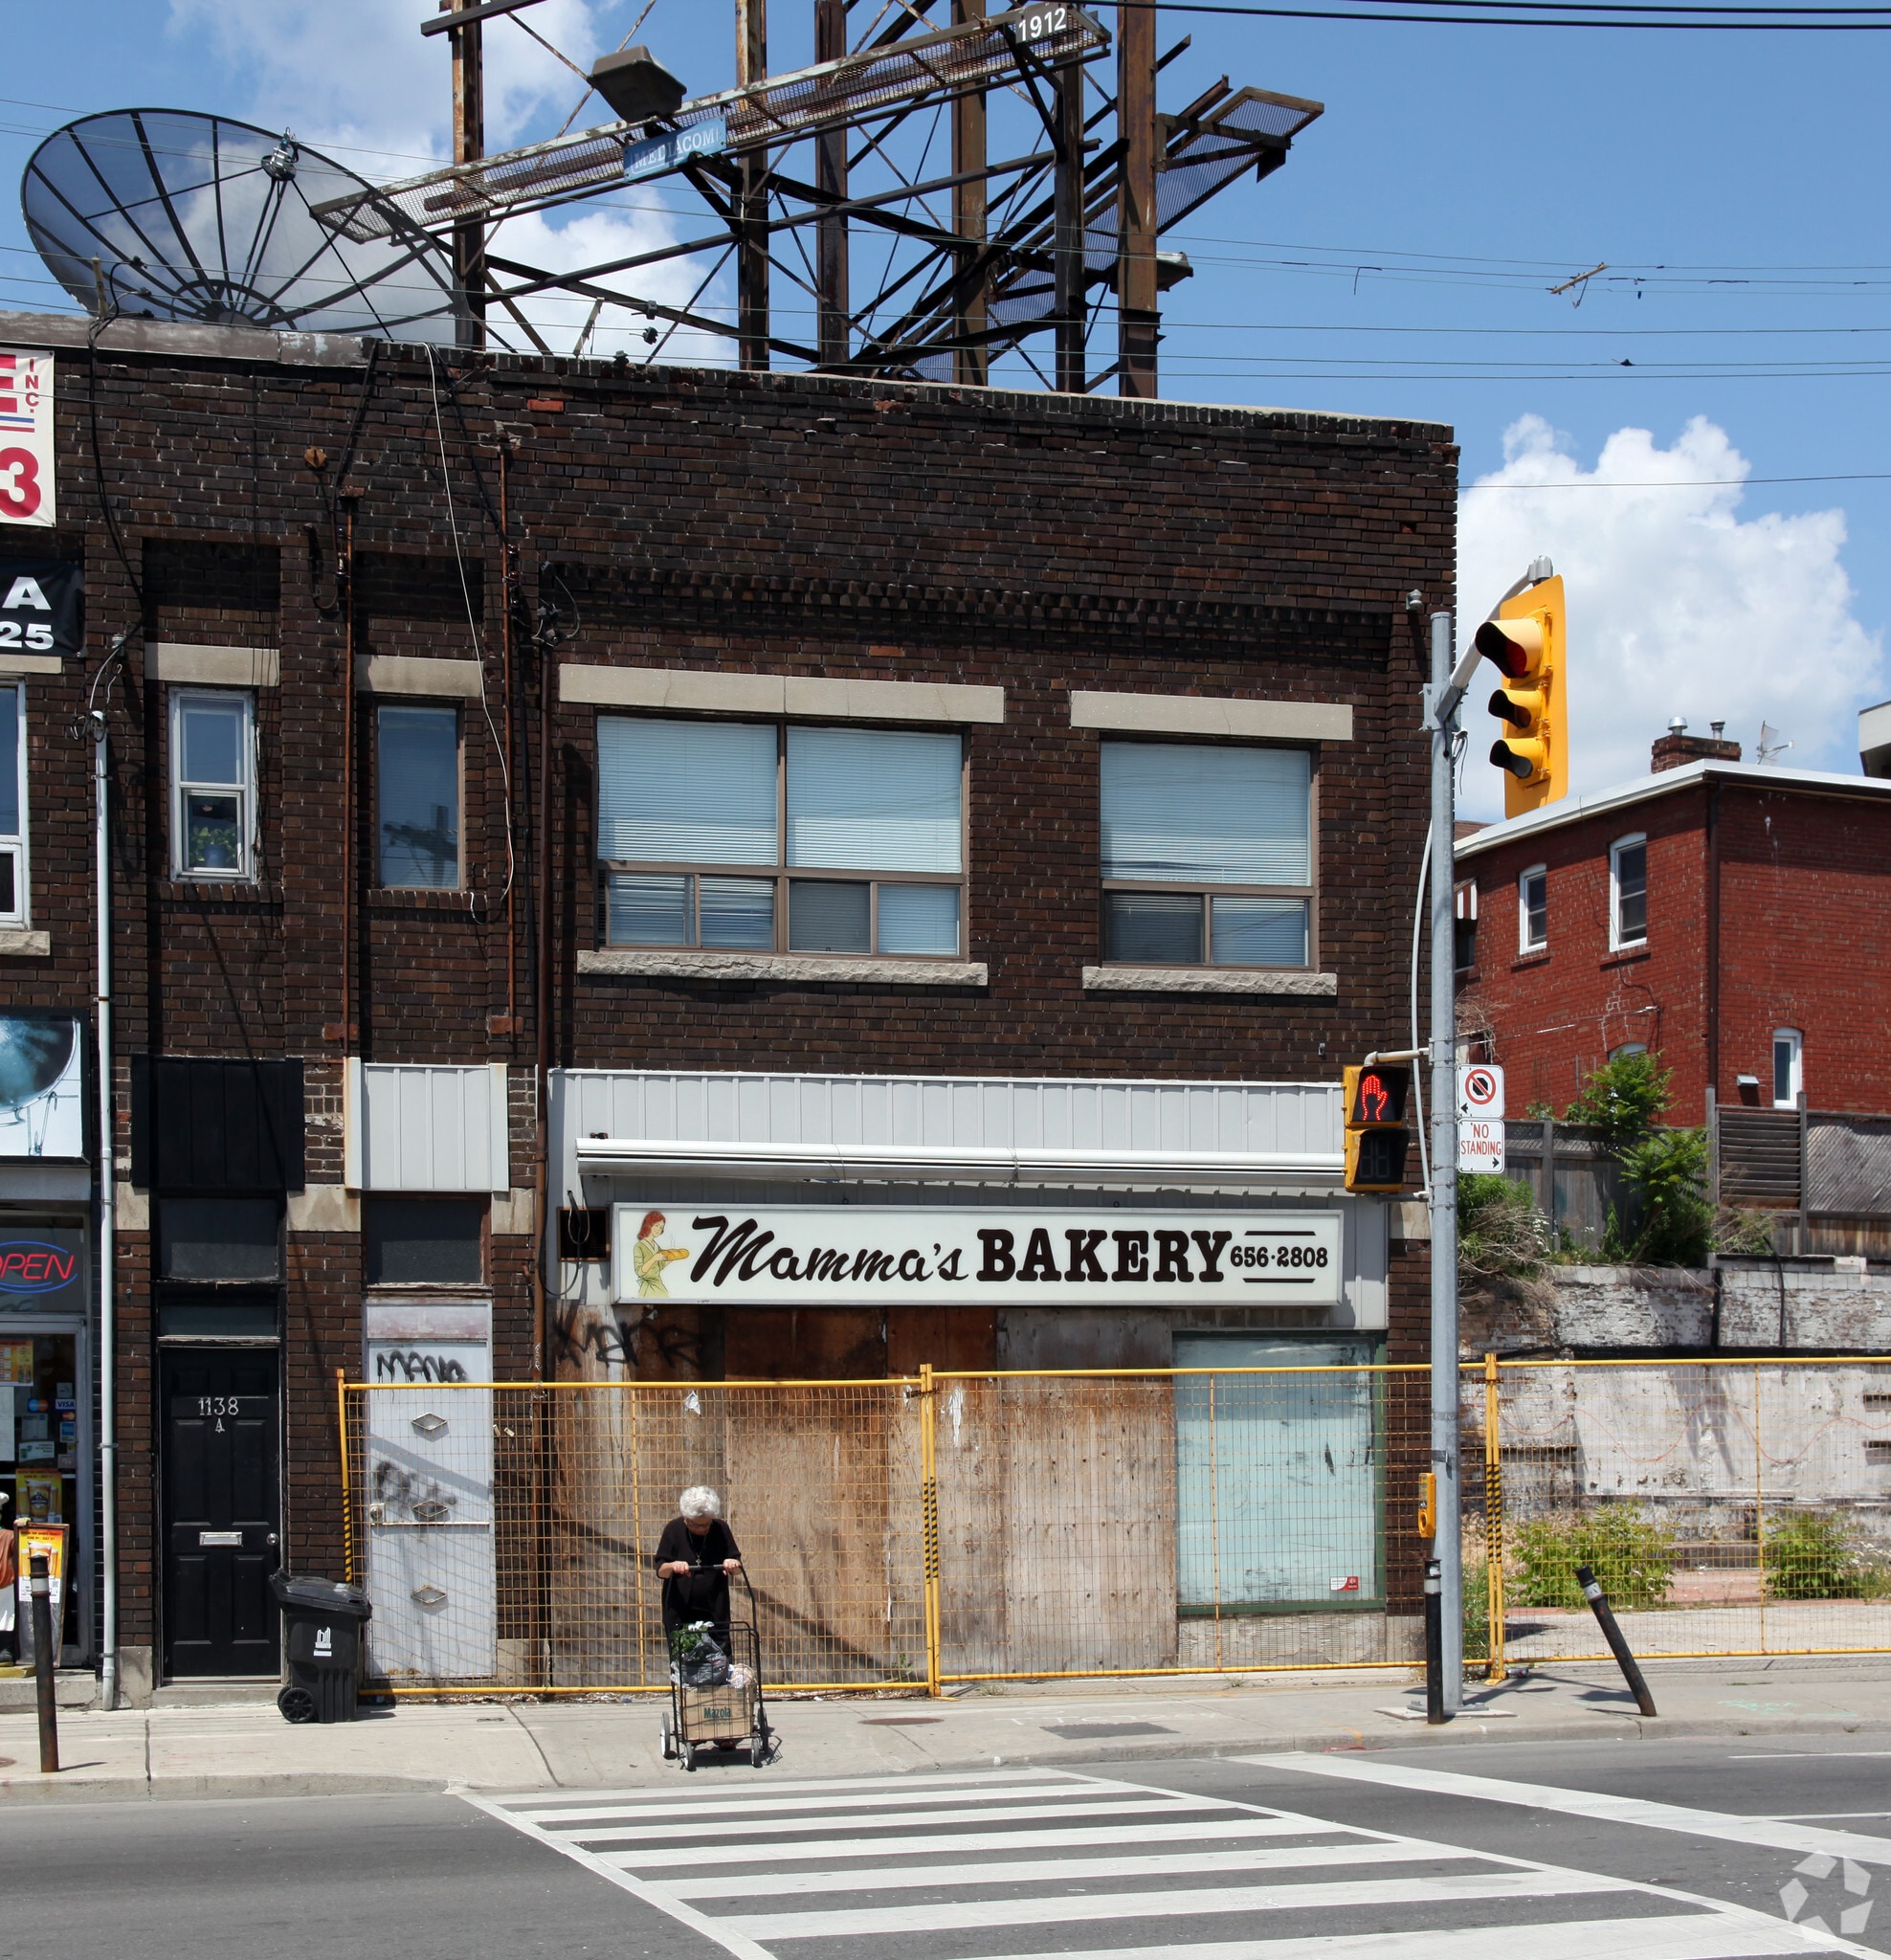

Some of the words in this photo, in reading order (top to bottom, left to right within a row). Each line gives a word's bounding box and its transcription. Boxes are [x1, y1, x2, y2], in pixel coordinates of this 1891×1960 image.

[1018, 7, 1067, 42] 1912
[634, 130, 715, 169] MEDIACOM
[0, 446, 41, 518] 3
[2, 575, 52, 610] A
[0, 620, 55, 650] 25
[1473, 1124, 1490, 1139] NO
[1460, 1140, 1502, 1156] STANDING
[689, 1214, 969, 1288] Mamma's
[976, 1228, 1233, 1282] BAKERY
[0, 1253, 75, 1280] PEN
[56, 1400, 75, 1409] VISA
[198, 1397, 239, 1416] 1138
[703, 1706, 732, 1719] Mazola
